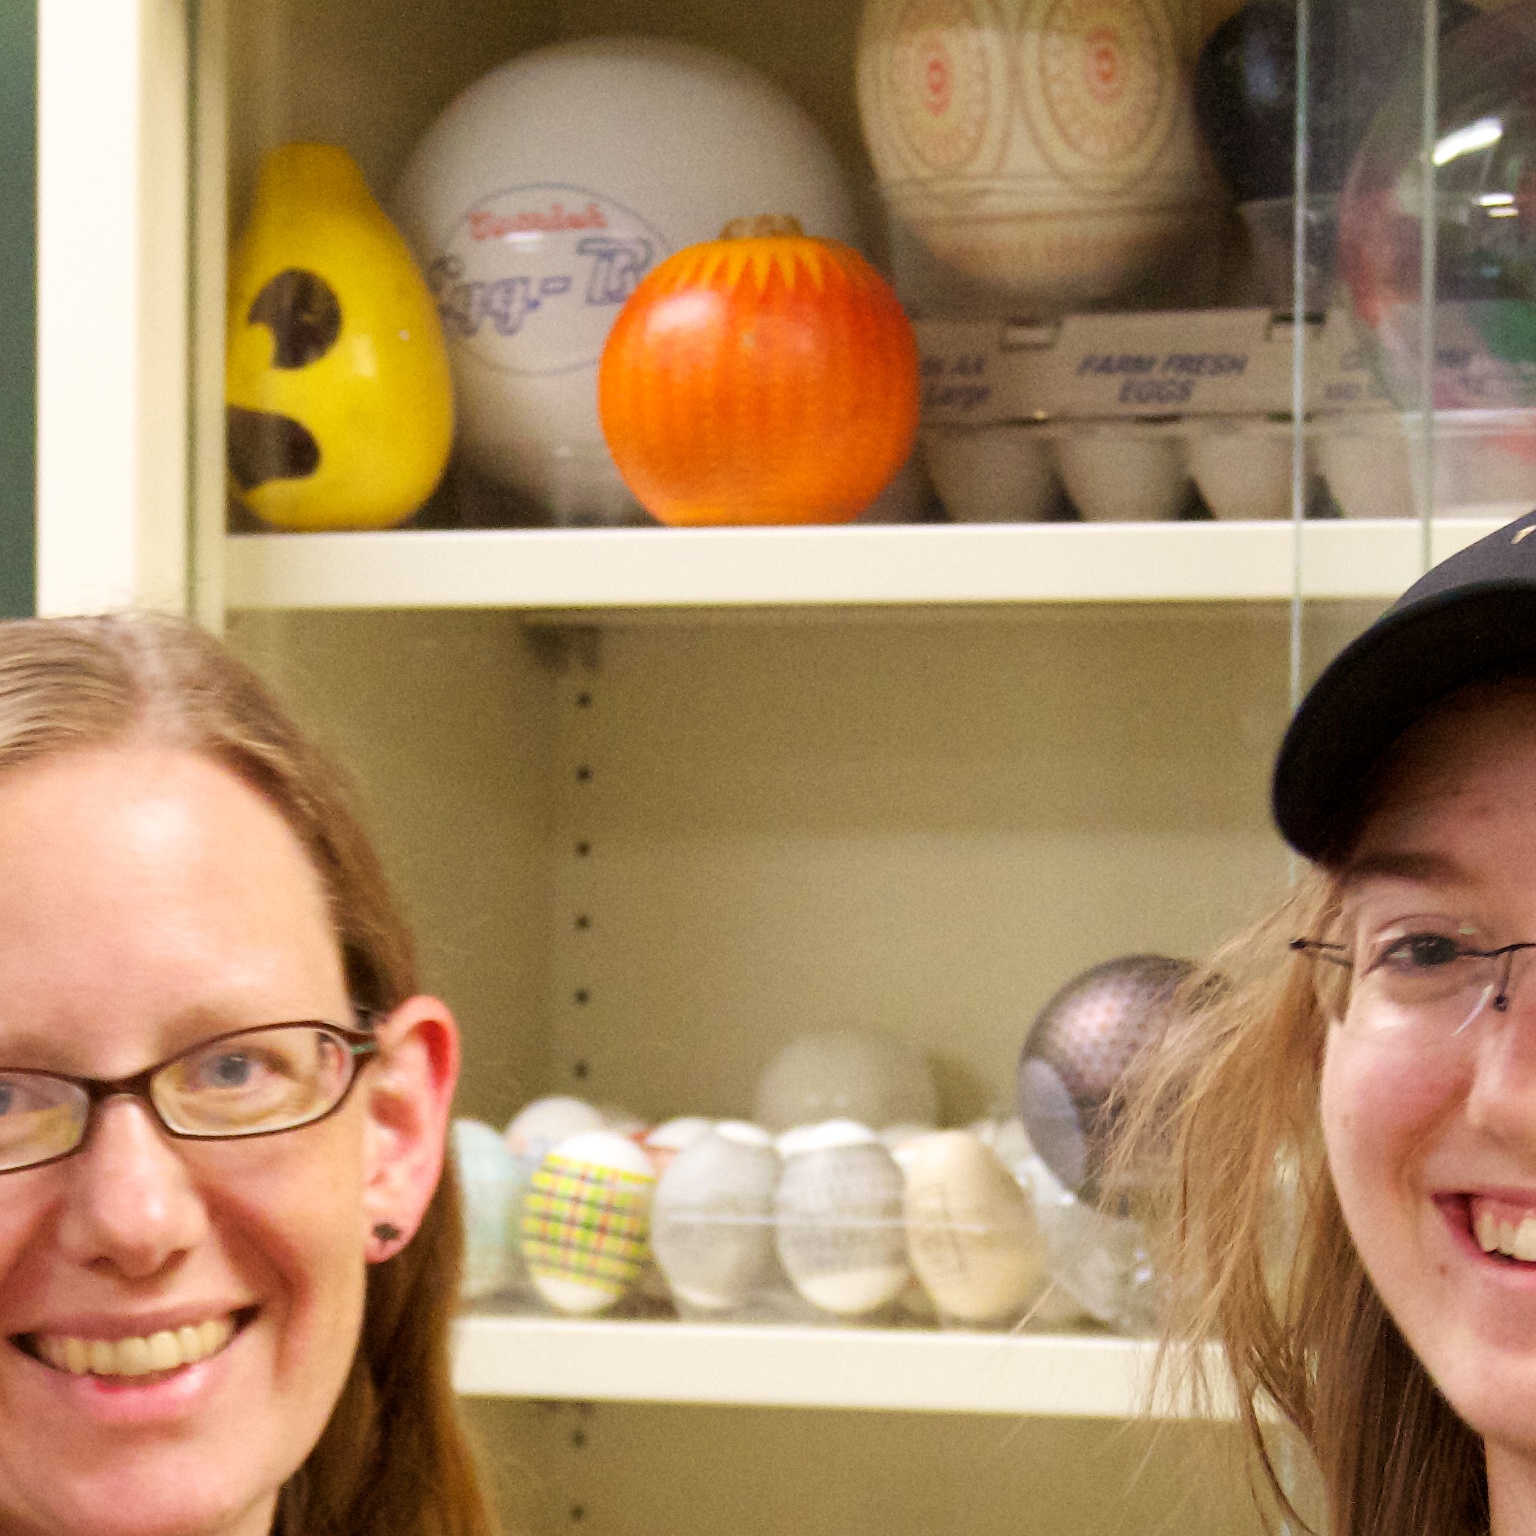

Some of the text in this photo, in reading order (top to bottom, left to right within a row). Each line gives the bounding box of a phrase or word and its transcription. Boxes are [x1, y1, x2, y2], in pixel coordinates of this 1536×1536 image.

[1078, 353, 1249, 376] FARM FRESH
[1119, 378, 1196, 404] EGGS
